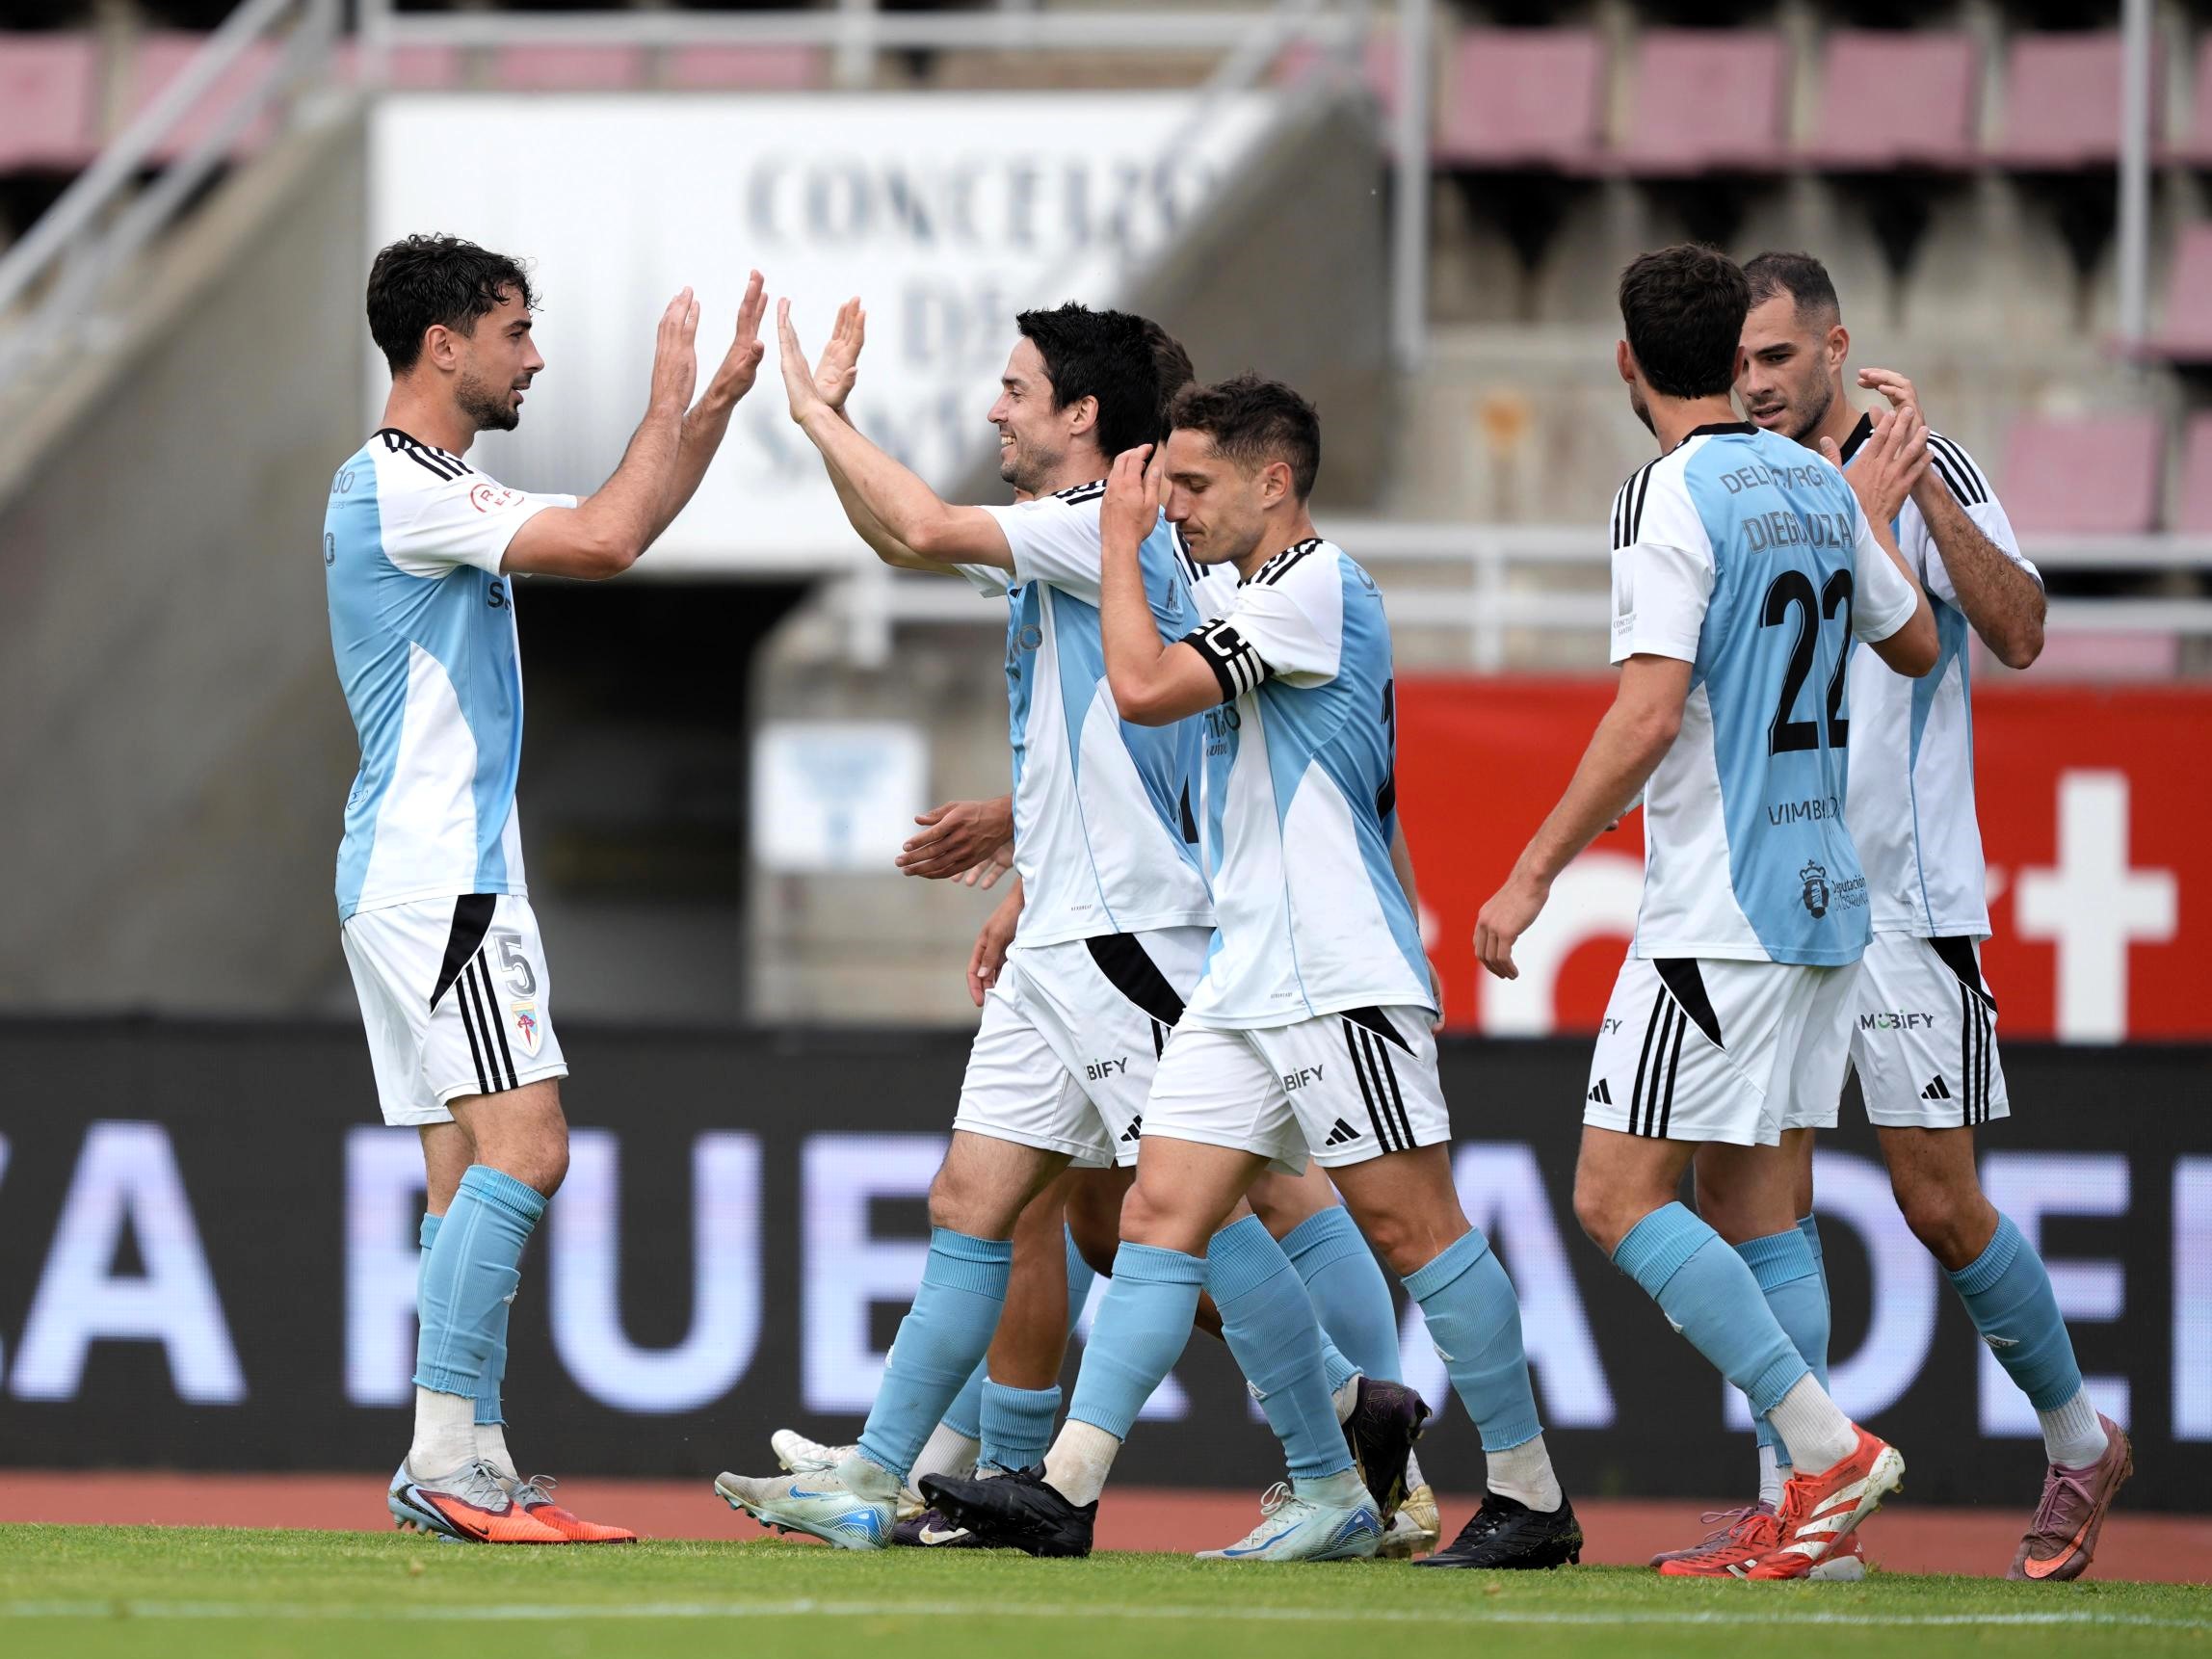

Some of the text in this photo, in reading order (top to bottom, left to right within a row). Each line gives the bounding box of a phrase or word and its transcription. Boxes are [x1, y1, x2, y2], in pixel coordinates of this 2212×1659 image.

[1760, 569, 1853, 757] 22
[493, 935, 537, 998] 5
[1087, 1057, 1127, 1080] BIFY
[1283, 1064, 1323, 1092] BIFY
